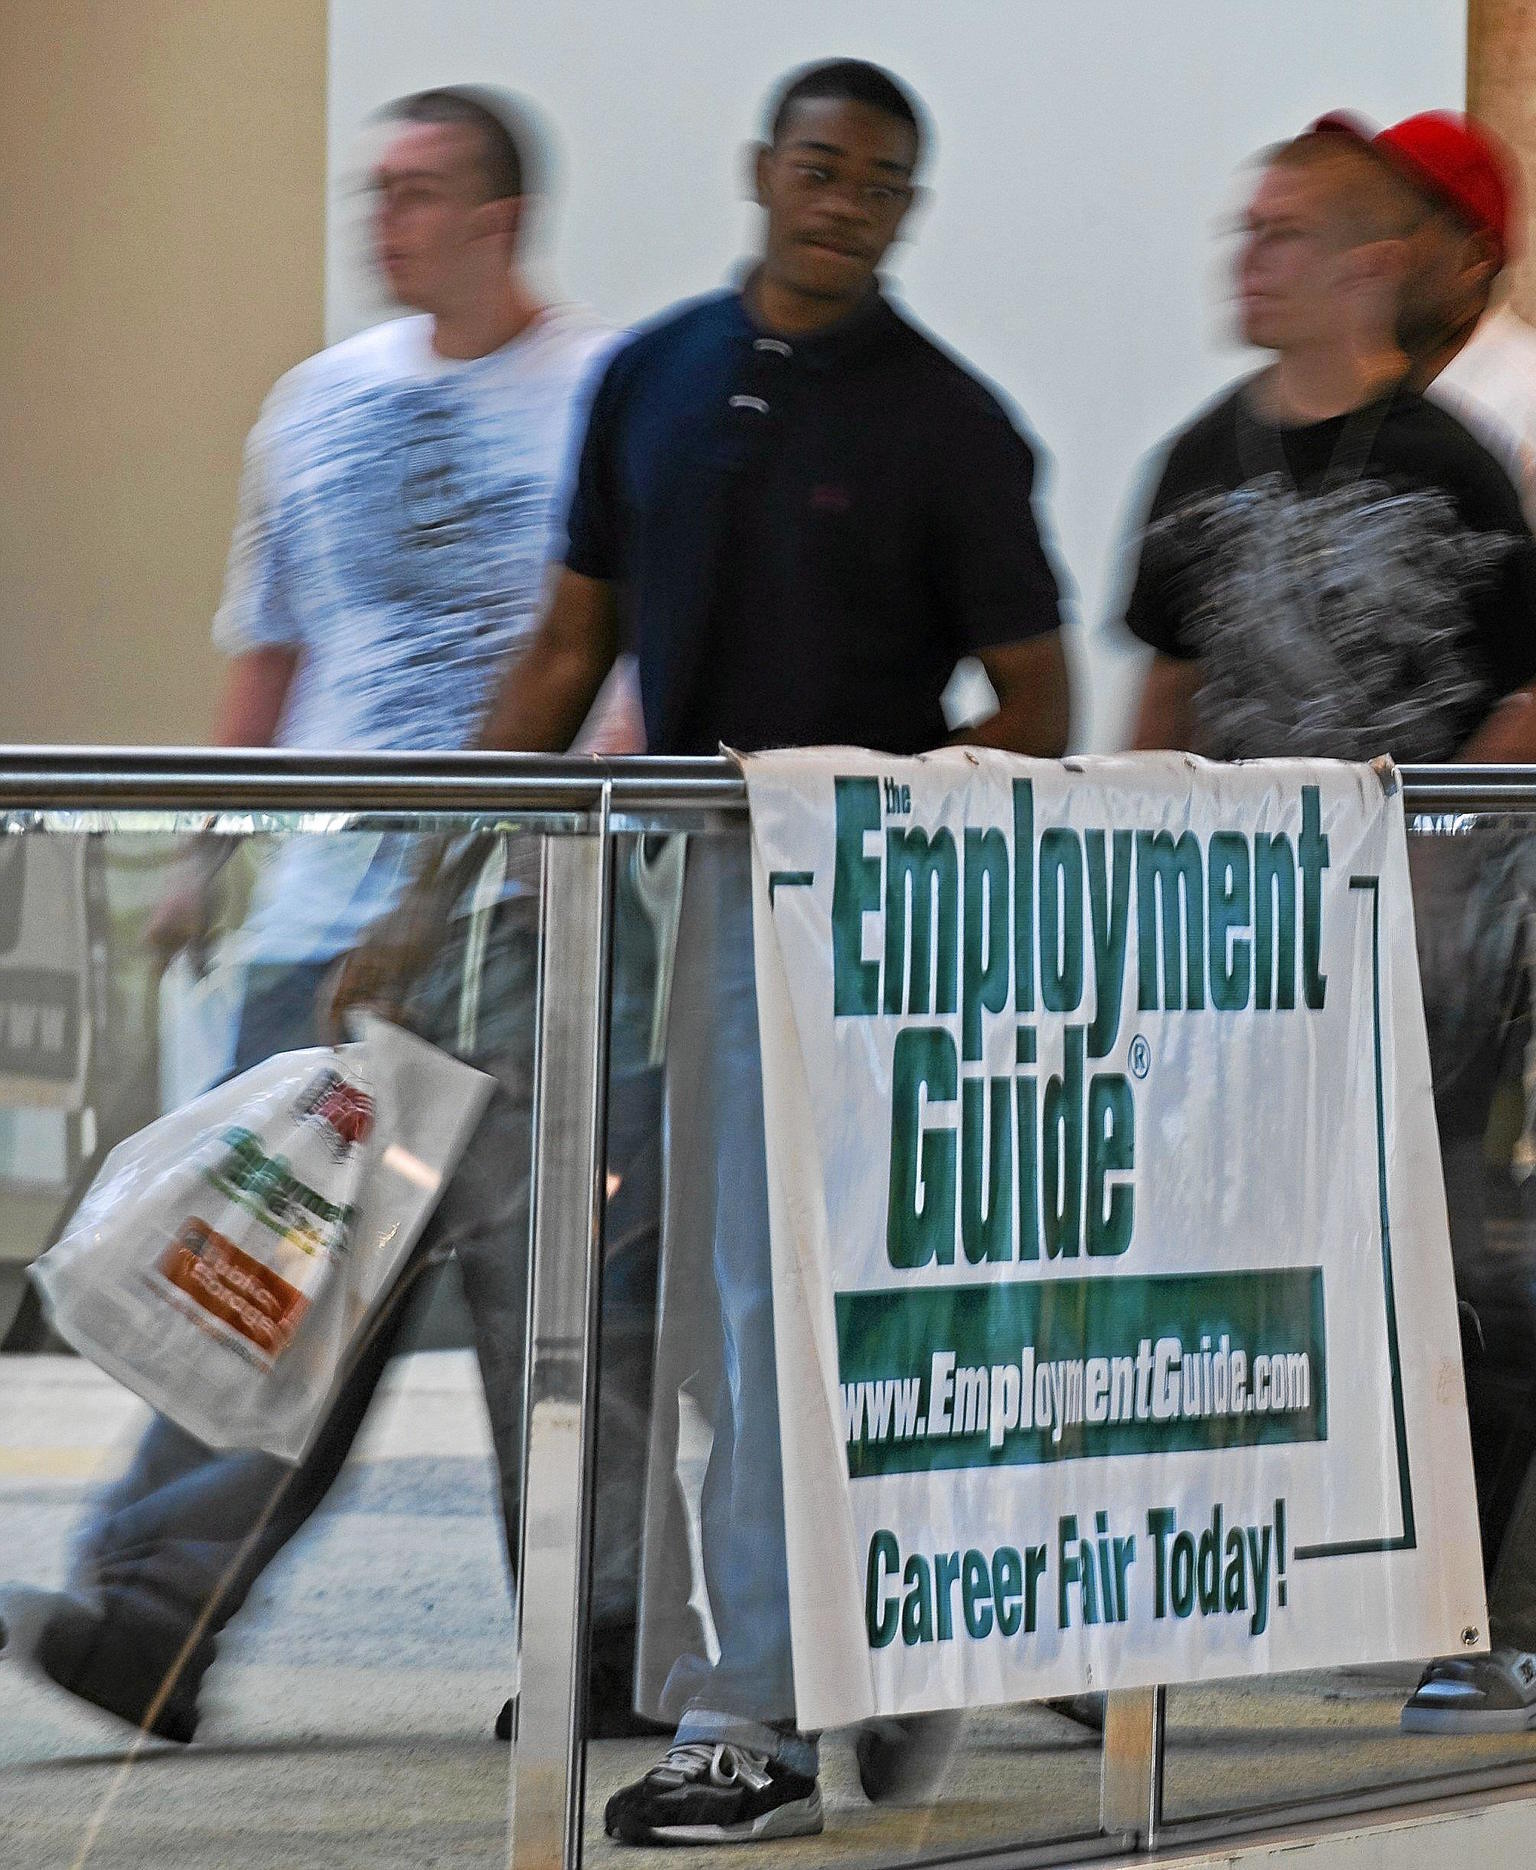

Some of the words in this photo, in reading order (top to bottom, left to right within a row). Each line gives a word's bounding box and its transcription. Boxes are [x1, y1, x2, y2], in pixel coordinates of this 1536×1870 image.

[884, 776, 911, 814] the
[832, 776, 1329, 1061] Employment
[887, 1025, 1135, 1269] Guide
[840, 1335, 1311, 1448] www.EmploymentGuide.com
[866, 1529, 1047, 1648] Career
[1059, 1510, 1136, 1629] Fair
[1148, 1498, 1288, 1636] Today!
